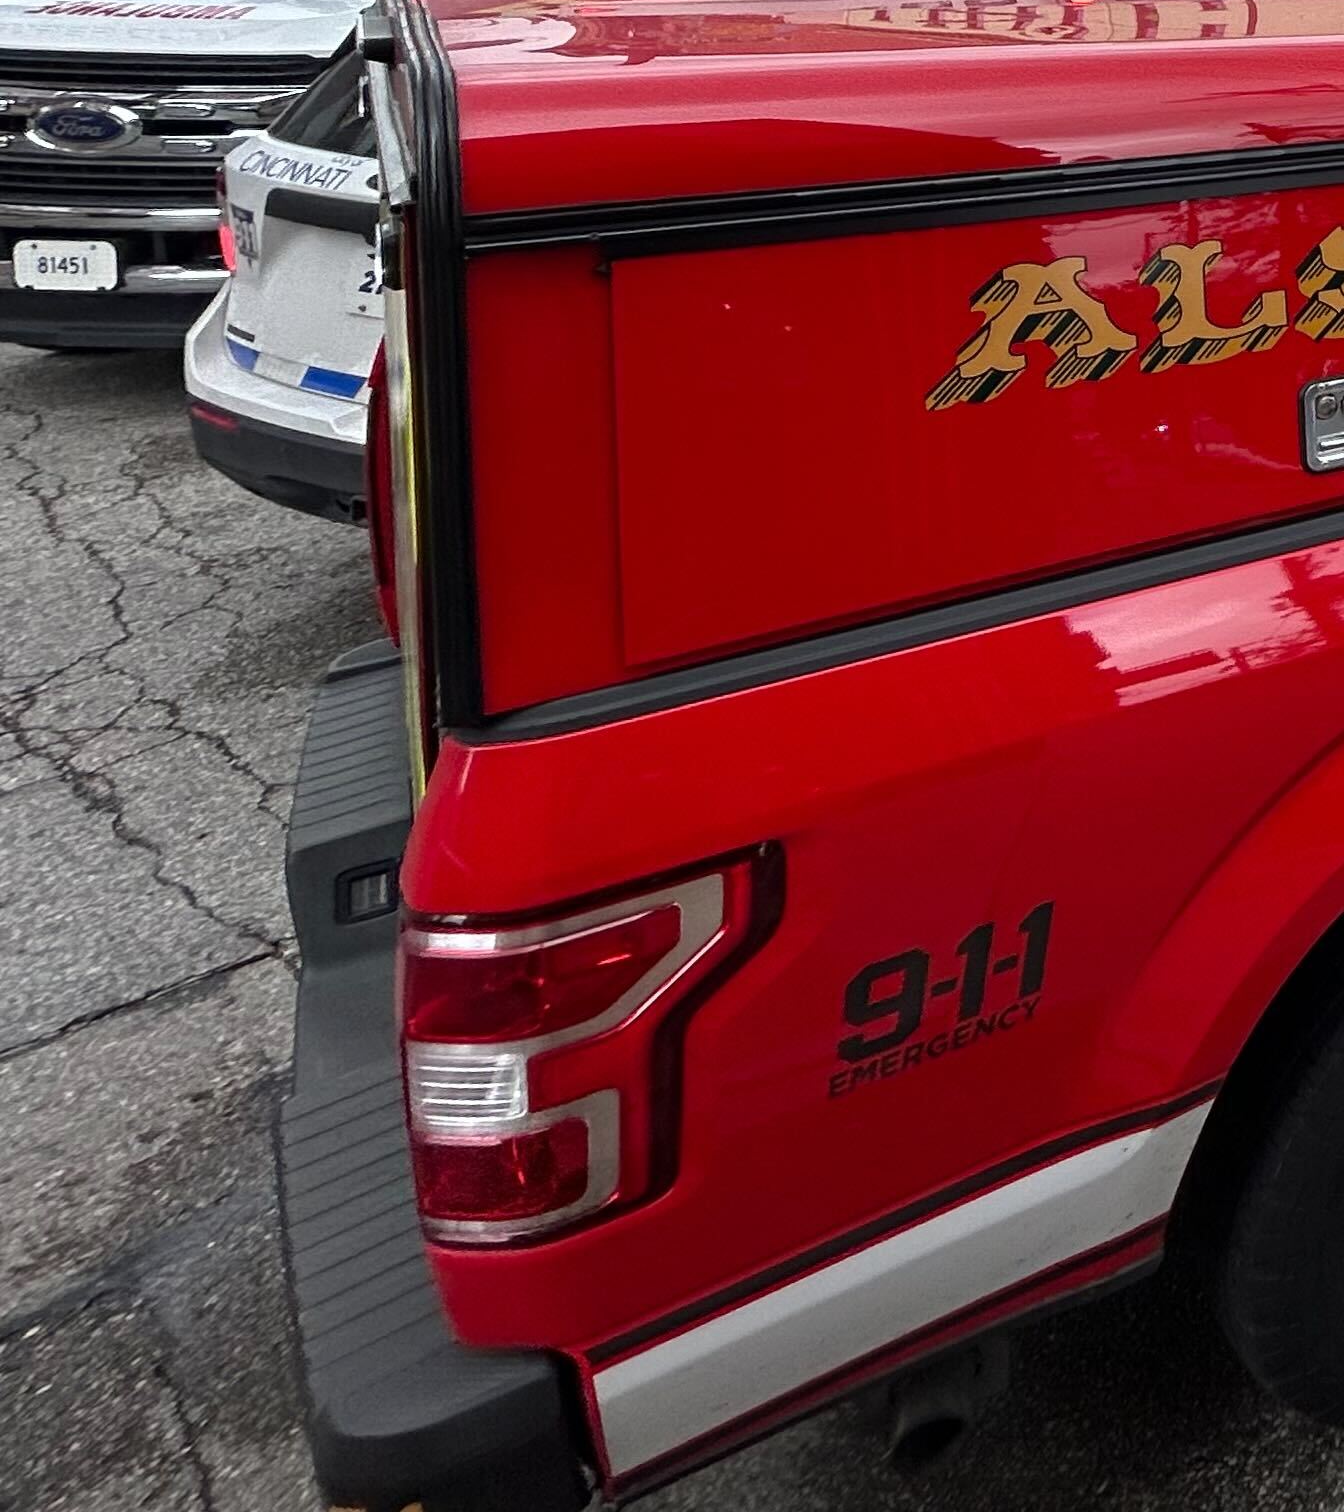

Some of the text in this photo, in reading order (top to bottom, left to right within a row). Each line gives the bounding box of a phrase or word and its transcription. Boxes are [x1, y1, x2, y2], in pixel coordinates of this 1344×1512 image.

[52, 115, 106, 137] Ford
[239, 150, 353, 190] CINCINNATI
[38, 256, 88, 275] 81451
[836, 899, 1055, 1064] 9-1-1
[827, 996, 1041, 1100] EMERGENCY
